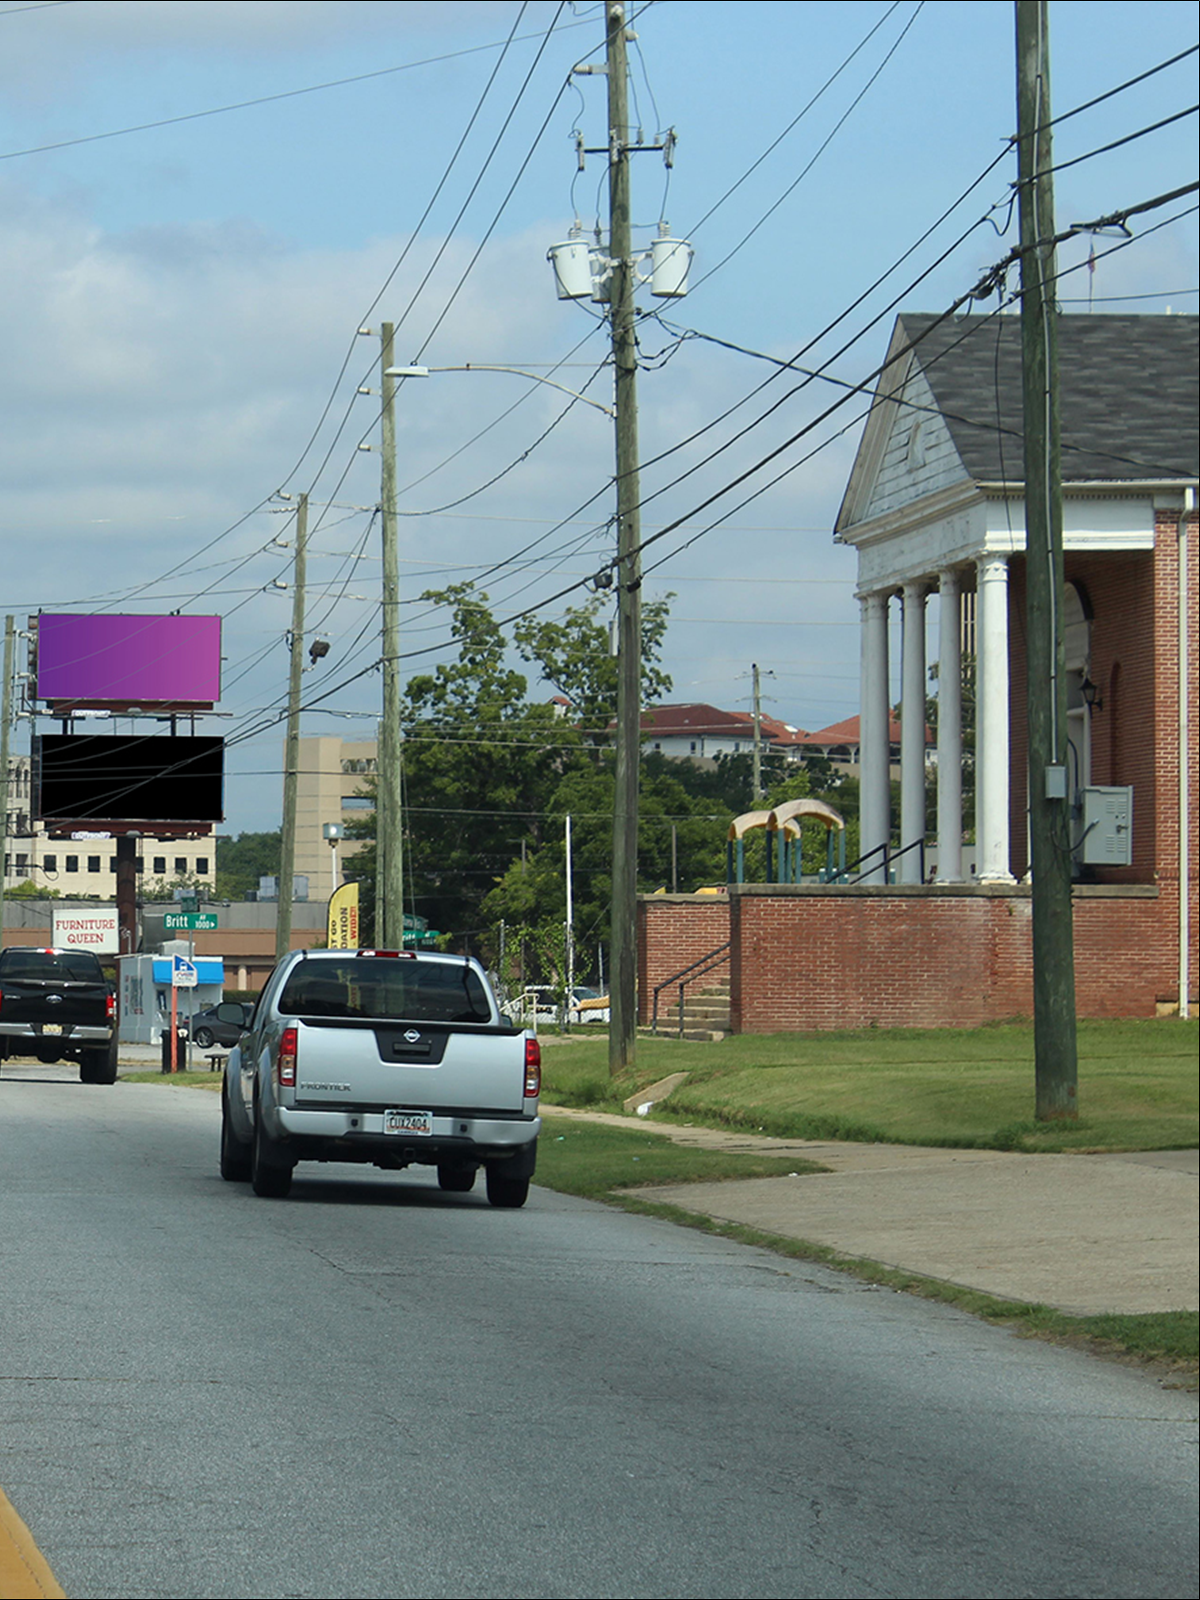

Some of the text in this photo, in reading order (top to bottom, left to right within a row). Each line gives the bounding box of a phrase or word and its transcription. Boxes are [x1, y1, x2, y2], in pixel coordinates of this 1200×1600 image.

[56, 919, 115, 930] FURNITURE
[166, 915, 188, 928] Britt
[195, 920, 210, 929] 1000
[331, 919, 338, 936] GO
[340, 907, 348, 949] DATION
[67, 933, 104, 944] QUEEN
[300, 1081, 351, 1092] FRONTIER
